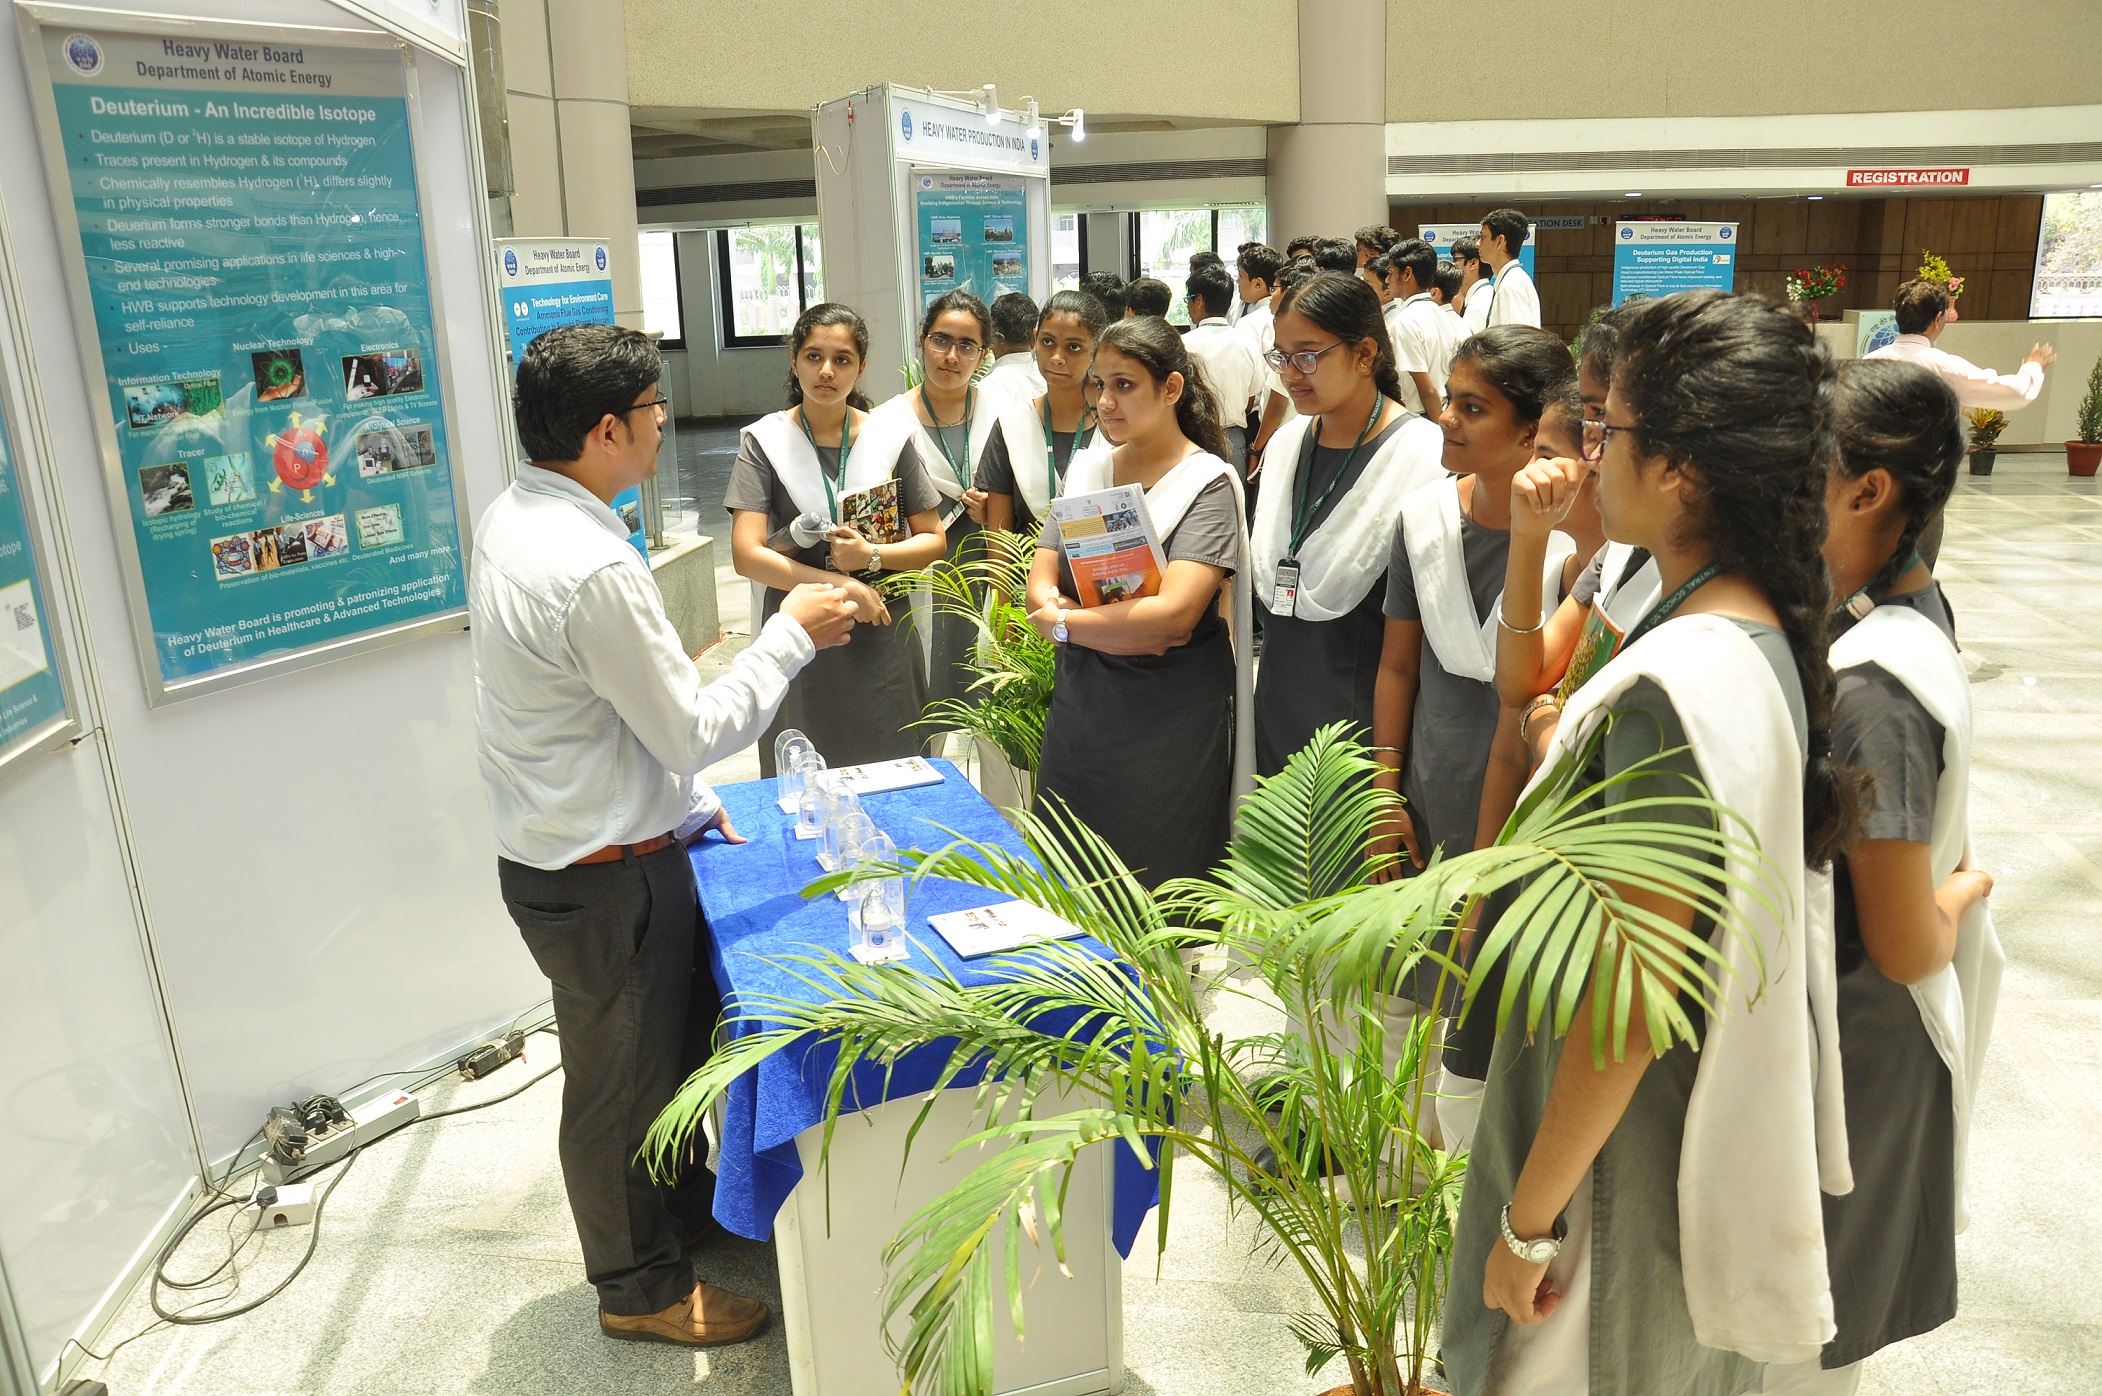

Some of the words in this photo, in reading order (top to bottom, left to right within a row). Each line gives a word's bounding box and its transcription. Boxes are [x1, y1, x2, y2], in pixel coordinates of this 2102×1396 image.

[163, 39, 210, 62] Heavy
[214, 43, 258, 61] Water
[263, 47, 304, 63] Board
[136, 61, 220, 80] Department
[224, 67, 236, 80] of
[242, 67, 286, 83] Atomic
[290, 70, 332, 88] Energy
[90, 96, 189, 116] Deuterium
[205, 101, 229, 117] An
[233, 102, 315, 120] Incredible
[319, 105, 376, 124] Isotope
[91, 130, 156, 144] Deuterium
[160, 132, 174, 146] (D
[178, 135, 190, 144] or
[215, 133, 224, 144] is
[228, 135, 235, 144] a
[239, 134, 270, 145] stable
[274, 134, 311, 147] isotope
[315, 134, 324, 145] of
[328, 135, 375, 147] Hydrogen
[922, 121, 944, 138] HEAVY
[946, 125, 967, 142] WATER
[968, 131, 1005, 148] PRODUCTION
[1005, 138, 1011, 149] IN
[1012, 138, 1025, 151] INDIA
[95, 153, 138, 166] Traces
[142, 155, 187, 169] present
[190, 155, 200, 166] in
[204, 154, 258, 170] Hydrogen
[261, 155, 270, 166] &
[273, 155, 285, 166] its
[288, 155, 347, 167] compounds
[100, 176, 170, 191] Chemically
[173, 177, 235, 189] resembles
[239, 176, 293, 190] Hydrogen
[323, 176, 354, 186] differs
[358, 175, 392, 188] slightly
[1852, 172, 1963, 183] REGISTRATION
[103, 197, 115, 209] in
[119, 196, 170, 211] physical
[174, 196, 233, 209] properties
[169, 218, 202, 230] forms
[206, 218, 250, 231] stronger
[255, 216, 287, 227] bonds
[290, 214, 312, 225] than
[316, 214, 366, 227] Hydrogn,
[111, 238, 135, 250] less
[139, 238, 185, 249] reactive
[115, 260, 160, 273] Several
[164, 257, 219, 272] promising
[222, 254, 285, 269] applications
[289, 253, 297, 263] in
[300, 251, 315, 262] life
[318, 251, 361, 262] sciences
[364, 249, 371, 259] &
[533, 249, 550, 262] Heavy
[550, 249, 565, 261] Water
[566, 249, 580, 259] Board
[525, 265, 553, 277] Department
[554, 263, 558, 274] of
[560, 264, 575, 273] Atomic
[576, 263, 590, 274] Energy
[118, 279, 141, 291] end
[144, 276, 217, 290] technologies
[122, 301, 154, 314] HWB
[158, 297, 207, 312] supports
[210, 294, 268, 308] technology
[271, 289, 337, 302] development
[339, 287, 348, 297] in
[351, 285, 368, 296] this
[371, 285, 392, 295] area
[395, 283, 407, 293] for
[531, 297, 561, 308] Technology
[561, 296, 570, 304] for
[597, 292, 608, 300] Care
[537, 310, 560, 320] Ammonia
[561, 308, 571, 317] Flue
[572, 307, 580, 315] Gas
[125, 317, 194, 332] self-reliance
[128, 342, 160, 354] Uses
[232, 341, 265, 351] Nuclear
[267, 336, 314, 348] Technology
[361, 342, 399, 352] Electronics
[118, 371, 170, 386] Information
[172, 368, 222, 381] Technology
[397, 417, 420, 426] Science
[178, 449, 205, 459] Tracer
[293, 464, 300, 473] P
[203, 507, 223, 516] Study
[280, 508, 325, 523] Life-Sciences
[352, 550, 385, 561] Deuterated
[389, 556, 405, 565] And
[408, 550, 428, 561] many
[219, 577, 260, 590] Preservation
[1659, 588, 1686, 614] SCHOOL
[168, 632, 202, 647] Heavy
[204, 624, 236, 638] Water
[238, 615, 270, 631] Board
[273, 613, 281, 621] is
[284, 601, 335, 621] promoting
[337, 597, 345, 606] &
[347, 585, 399, 605] patronizing
[401, 573, 450, 592] application
[184, 645, 195, 657] of
[198, 634, 253, 654] Deuterium
[255, 630, 265, 639] in
[268, 618, 321, 636] Healthcare
[324, 613, 331, 623] &
[333, 604, 380, 621] Advanced
[381, 587, 441, 608] Technologies
